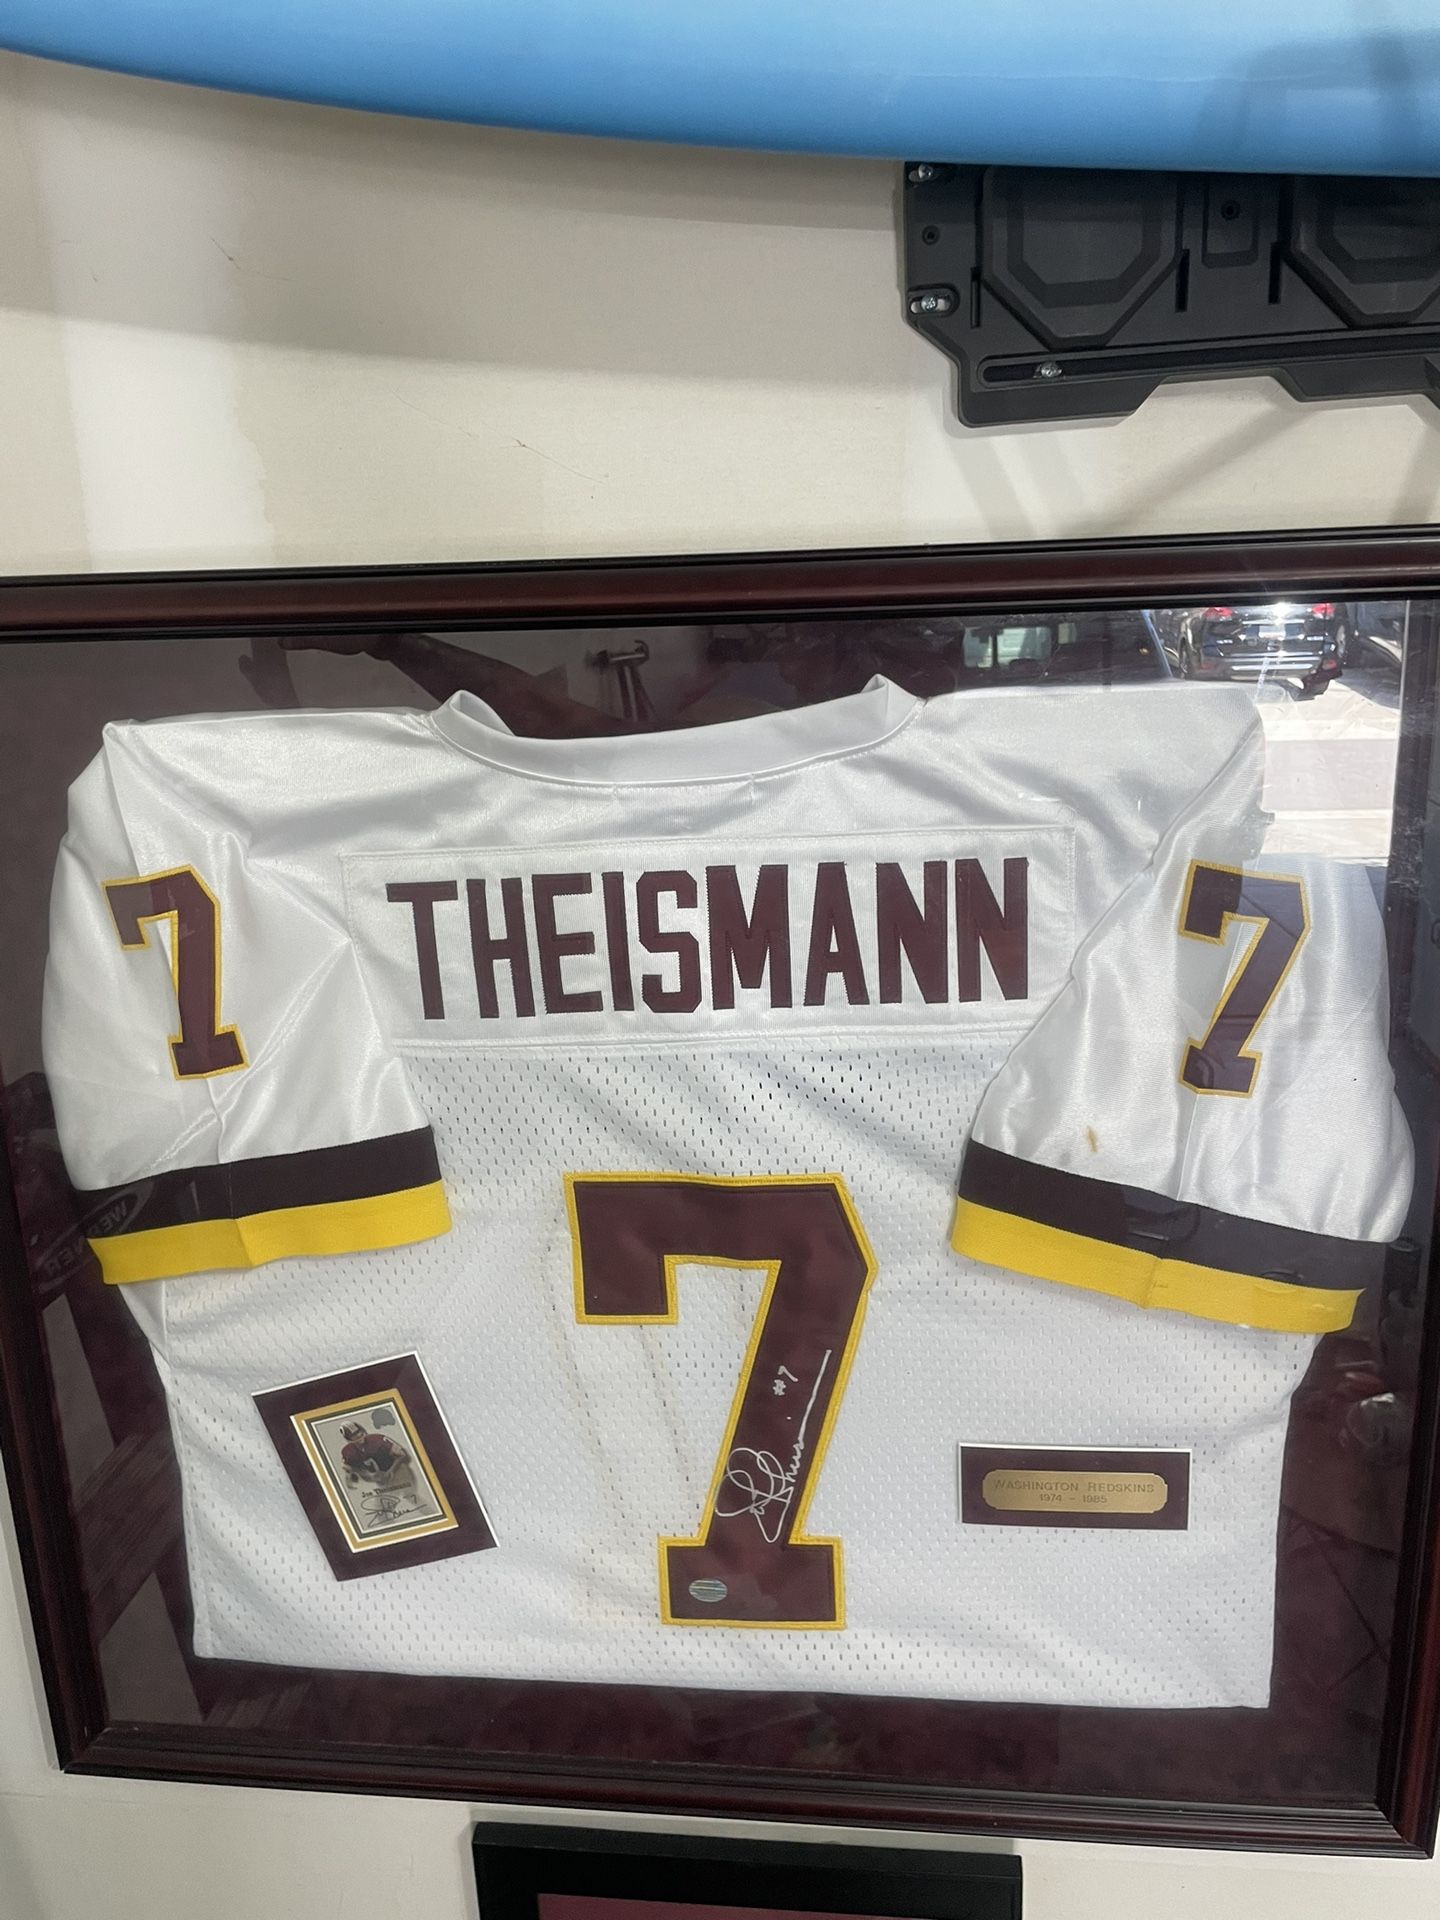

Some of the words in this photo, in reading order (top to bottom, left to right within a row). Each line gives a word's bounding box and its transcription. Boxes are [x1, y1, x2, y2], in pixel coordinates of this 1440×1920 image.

[102, 864, 249, 1080] 7
[386, 857, 1028, 1019] THEISMANN
[1178, 859, 1311, 1098] 7
[564, 1172, 878, 1630] 7
[993, 1479, 1079, 1491] WASHINGTON
[1088, 1482, 1155, 1493] REDSKINS
[1039, 1494, 1062, 1503] 1974
[1082, 1495, 1108, 1504] 1985
